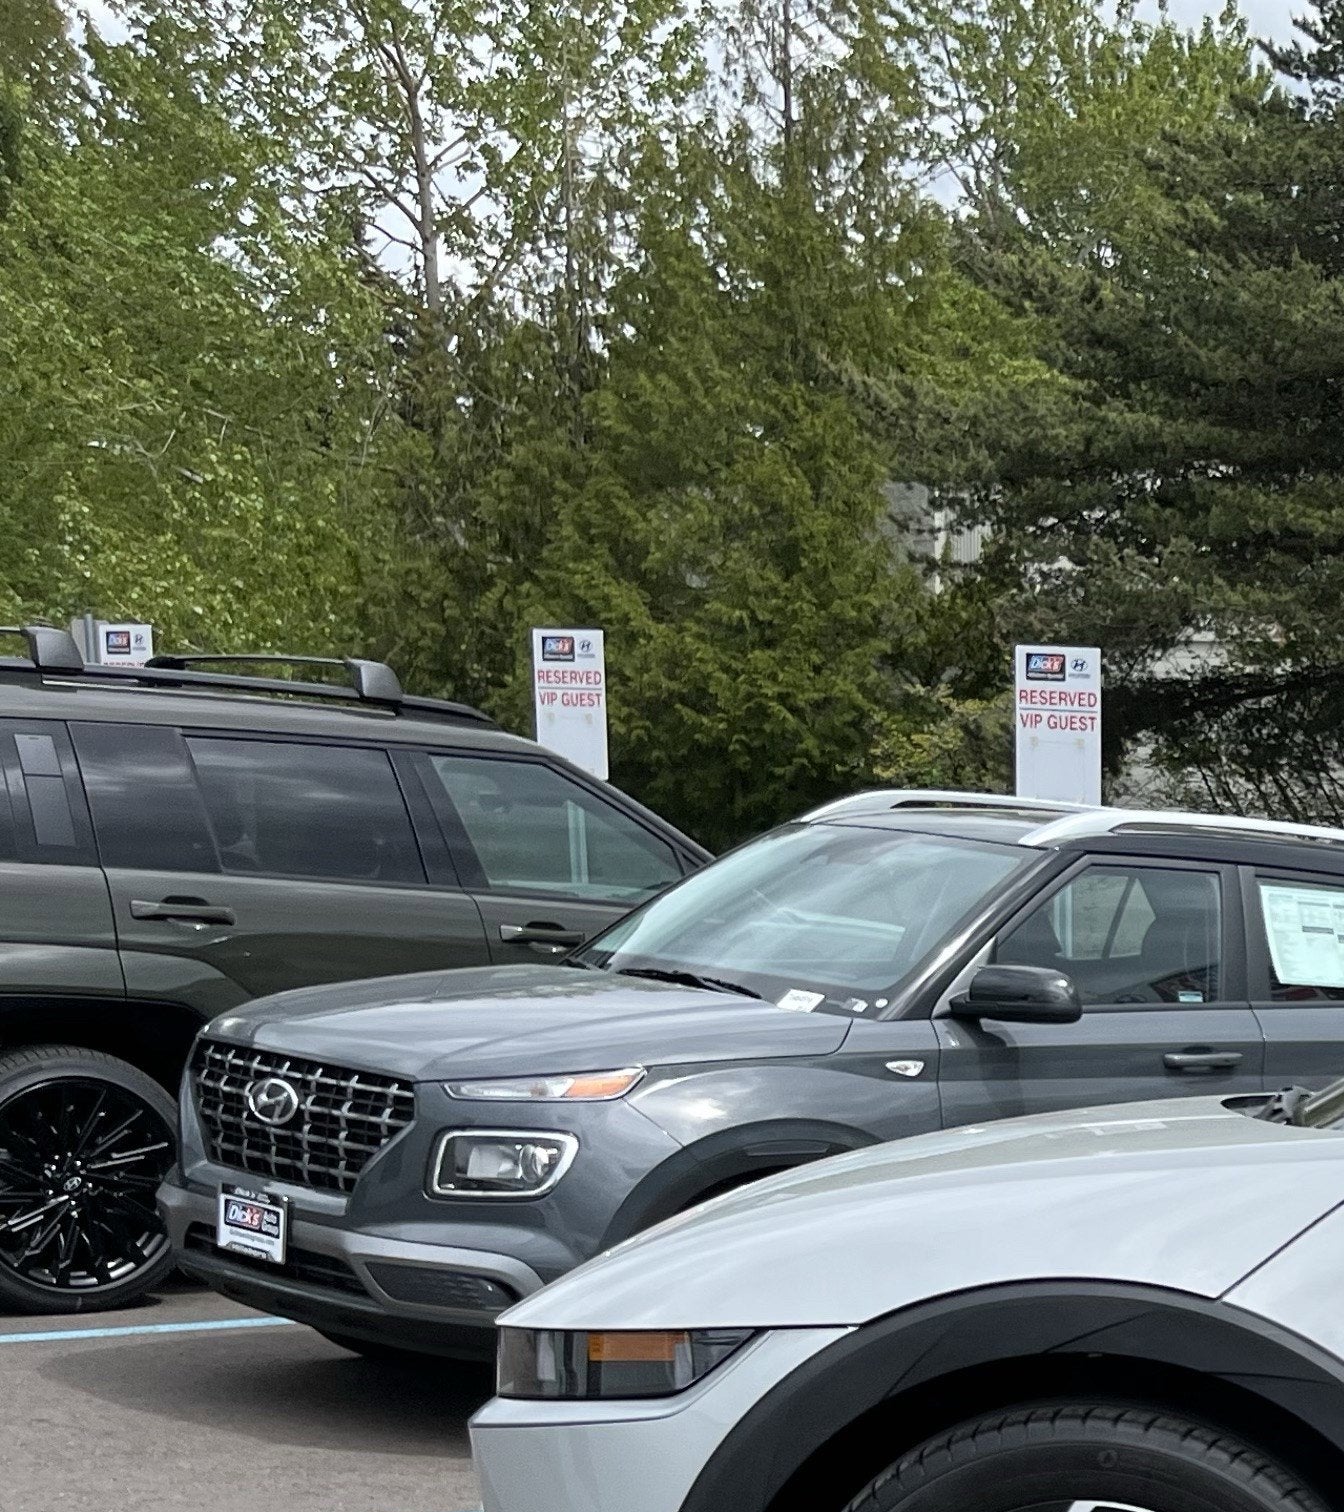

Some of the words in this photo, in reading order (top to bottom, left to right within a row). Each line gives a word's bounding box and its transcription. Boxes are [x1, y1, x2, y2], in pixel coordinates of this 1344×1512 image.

[537, 670, 602, 686] RESERVED
[539, 692, 558, 706] VIP
[561, 693, 602, 708] GUEST
[1019, 690, 1097, 708] RESERVED
[1020, 713, 1043, 729] VIP
[1047, 714, 1097, 732] GUEST
